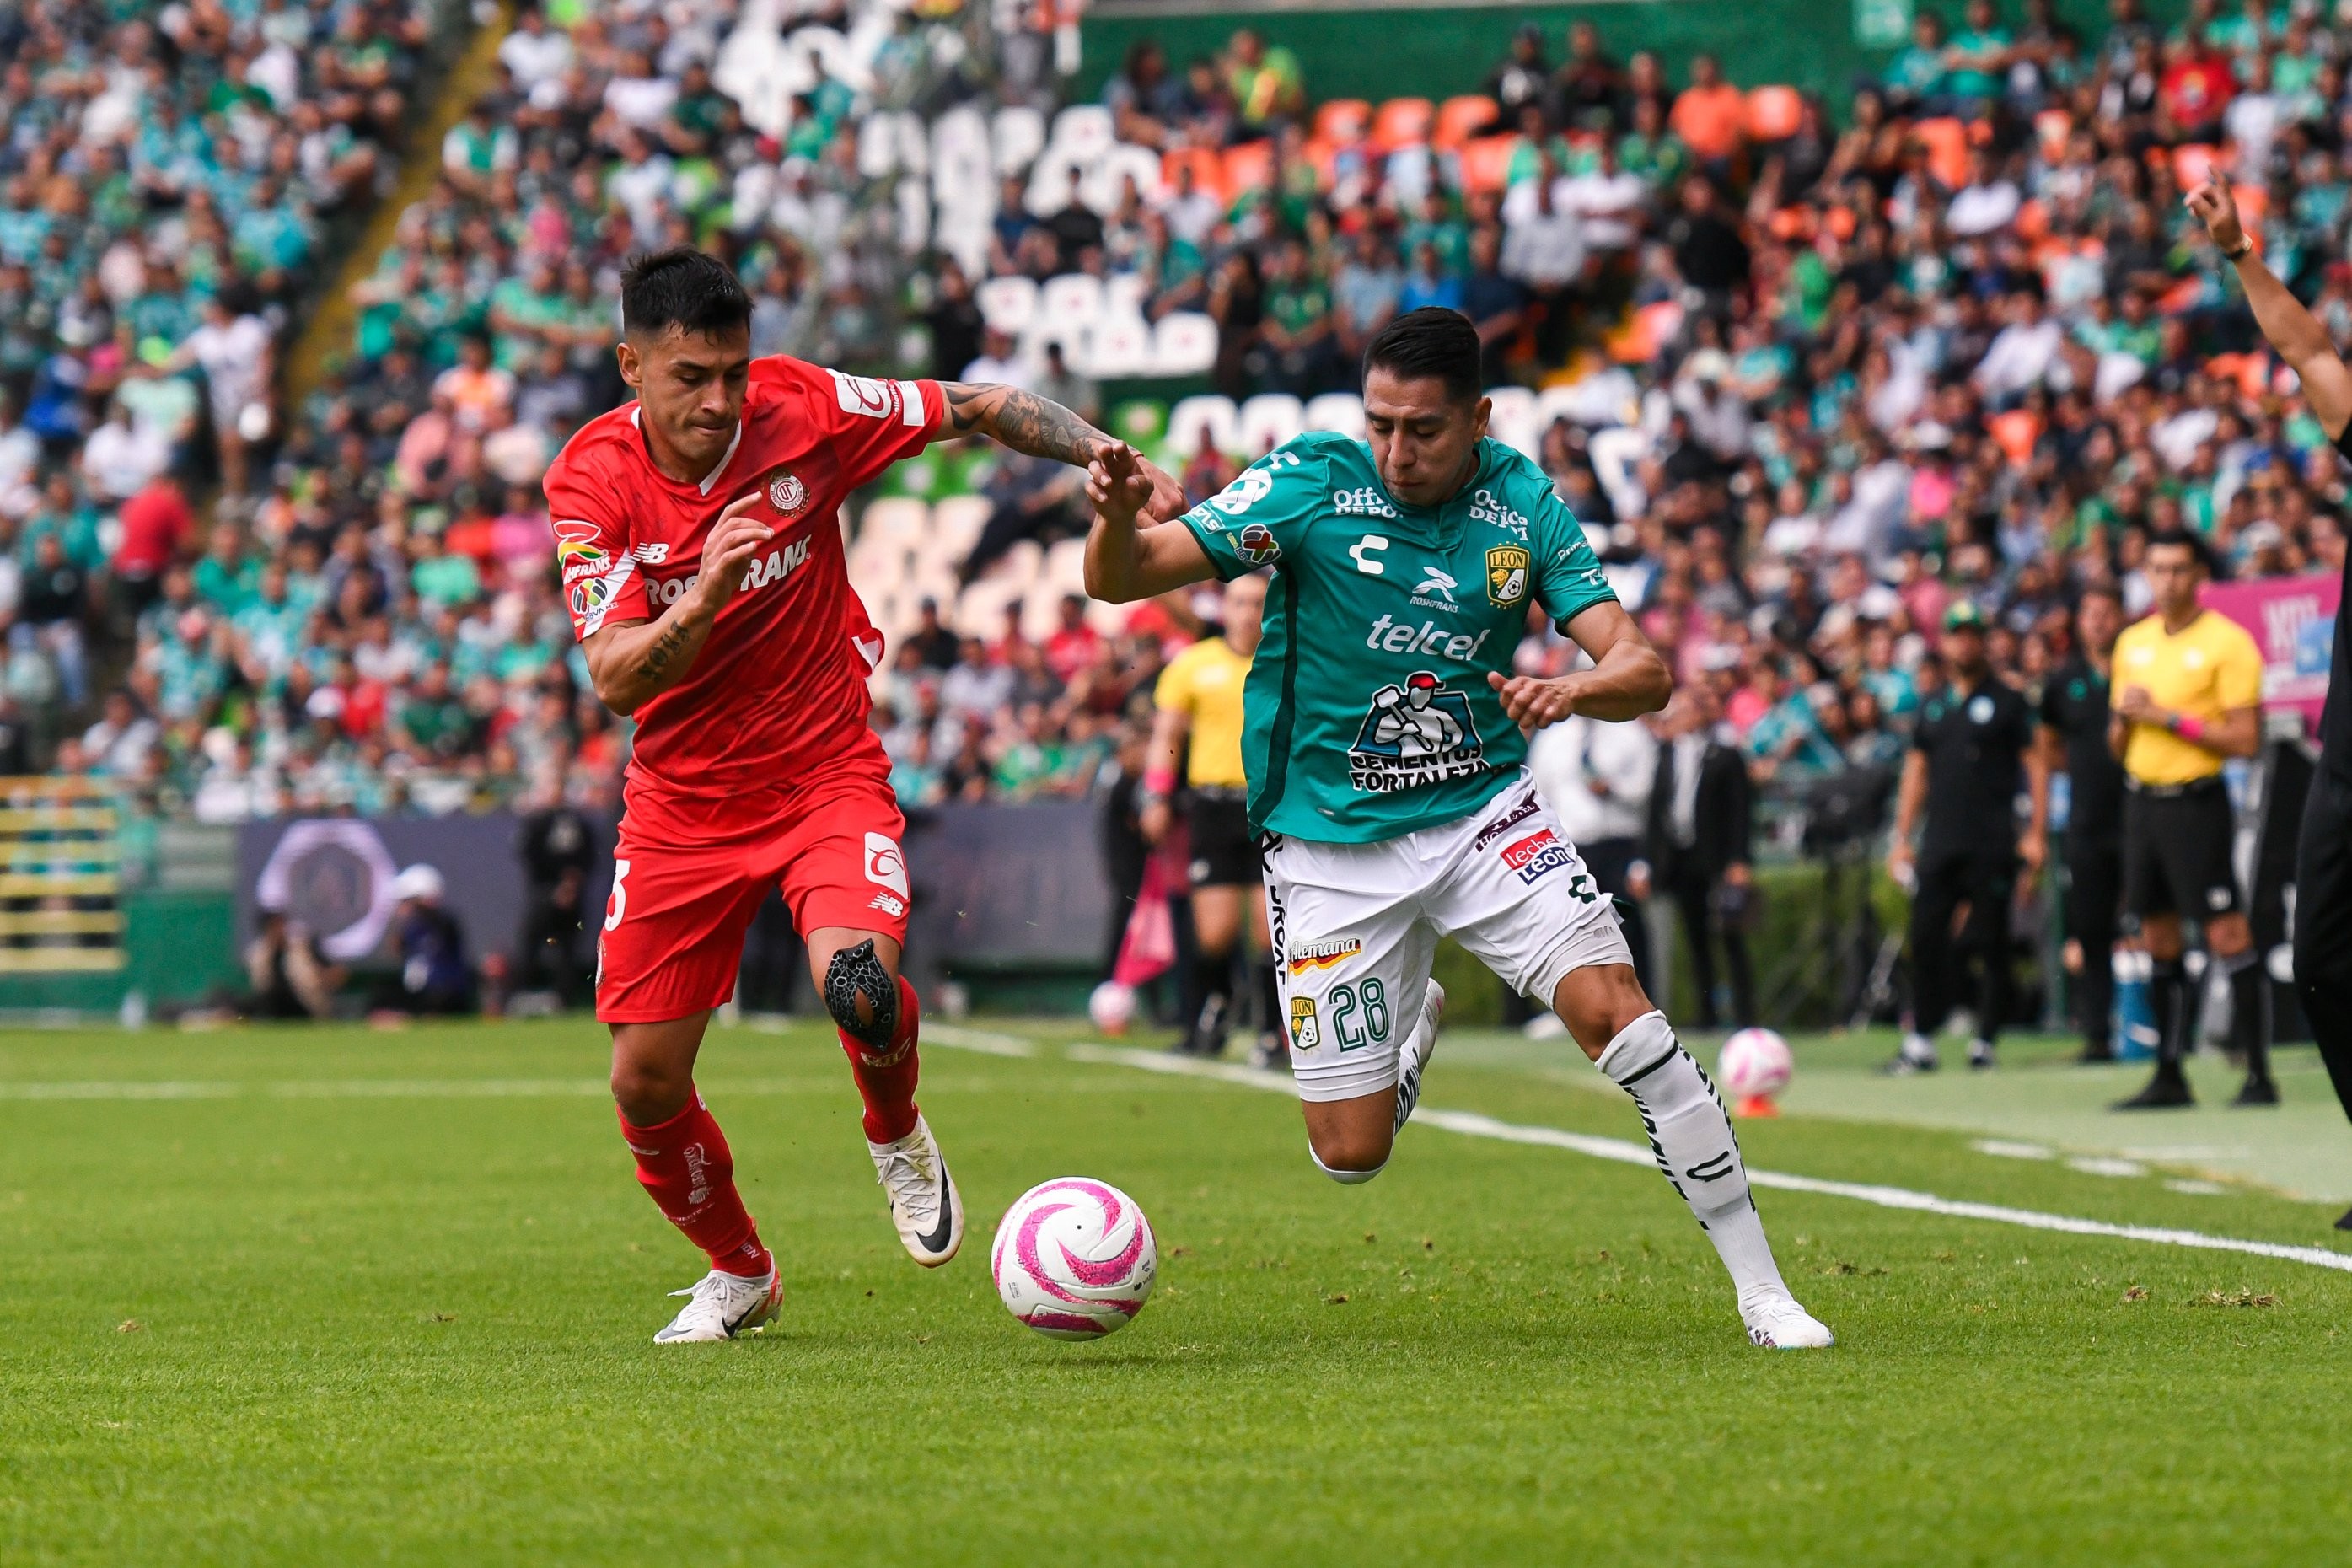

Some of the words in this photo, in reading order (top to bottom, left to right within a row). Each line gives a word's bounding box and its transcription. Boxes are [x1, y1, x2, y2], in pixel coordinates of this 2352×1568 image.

[1492, 551, 1524, 568] LEON
[1410, 595, 1459, 614] ROSHFRANS
[1367, 614, 1491, 661] telcel
[1506, 837, 1557, 867] leche
[1289, 937, 1356, 961] Alemana
[1328, 977, 1390, 1053] 28
